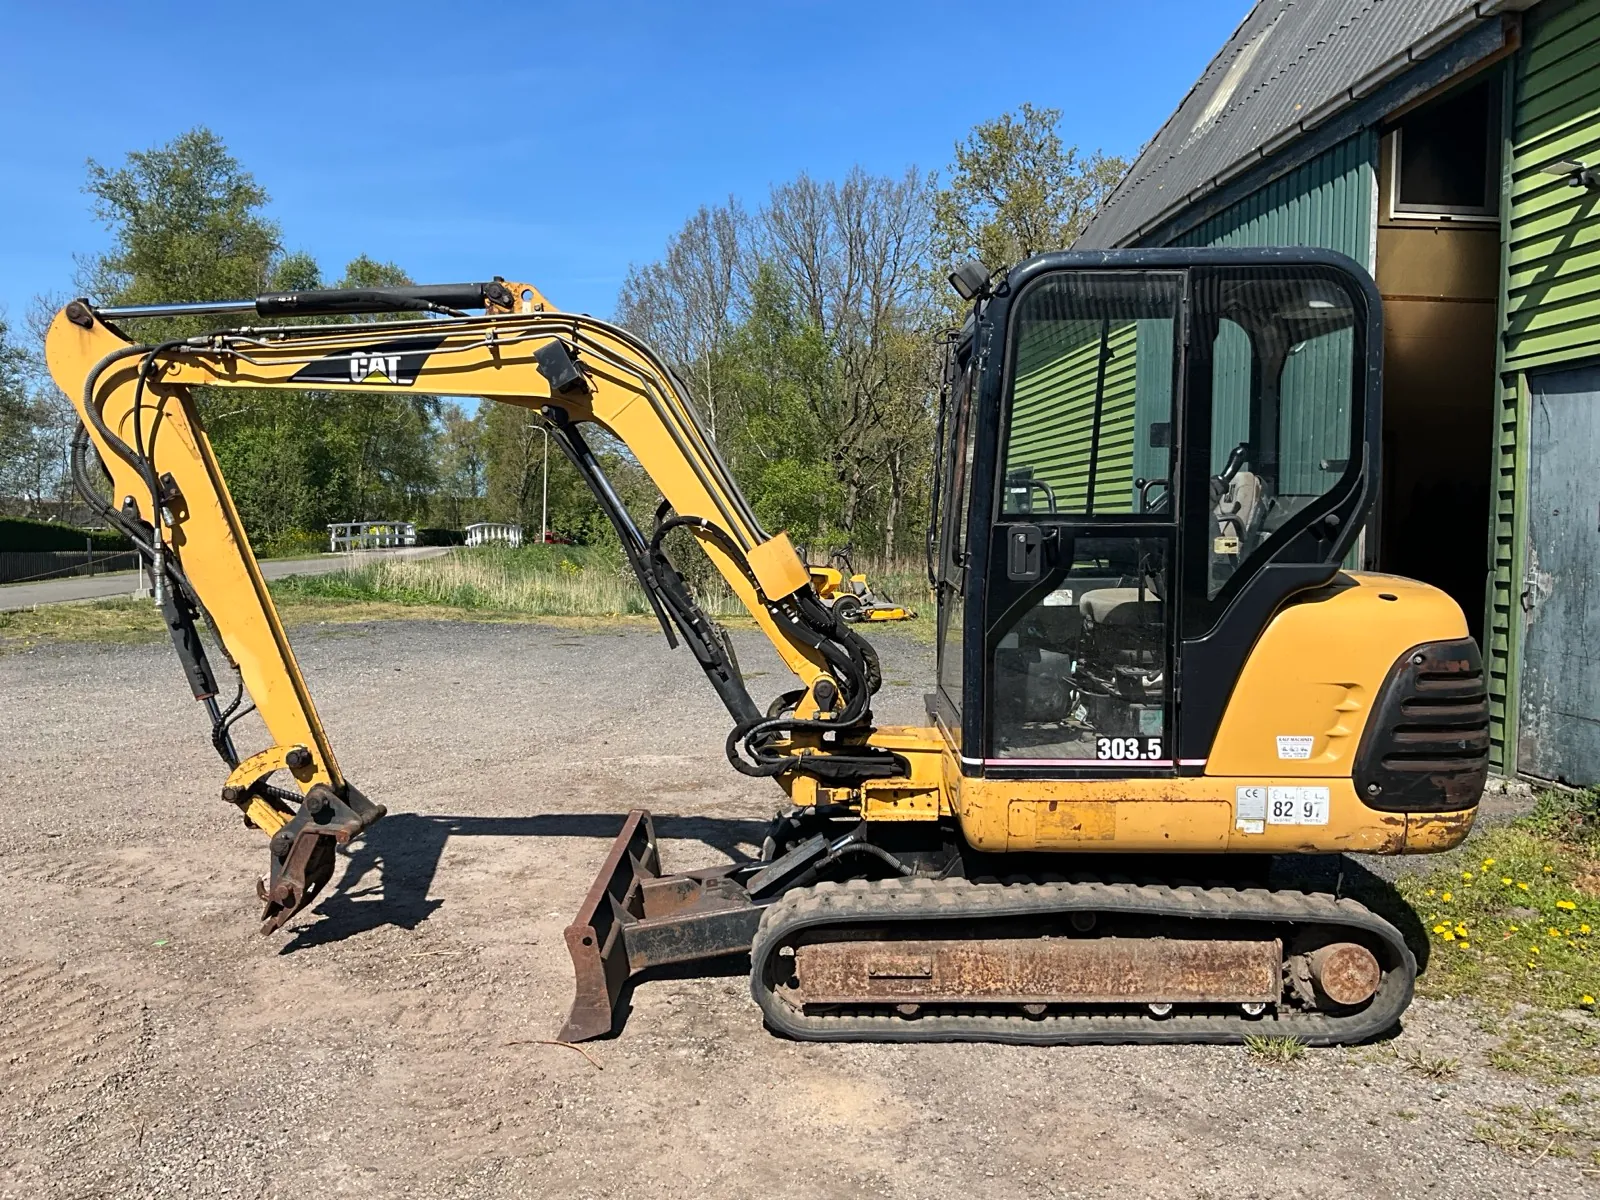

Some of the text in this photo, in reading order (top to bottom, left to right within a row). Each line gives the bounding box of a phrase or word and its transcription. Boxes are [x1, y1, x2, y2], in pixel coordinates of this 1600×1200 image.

[351, 351, 401, 383] CAT
[1097, 737, 1162, 760] 303.5
[1273, 800, 1294, 817] 82
